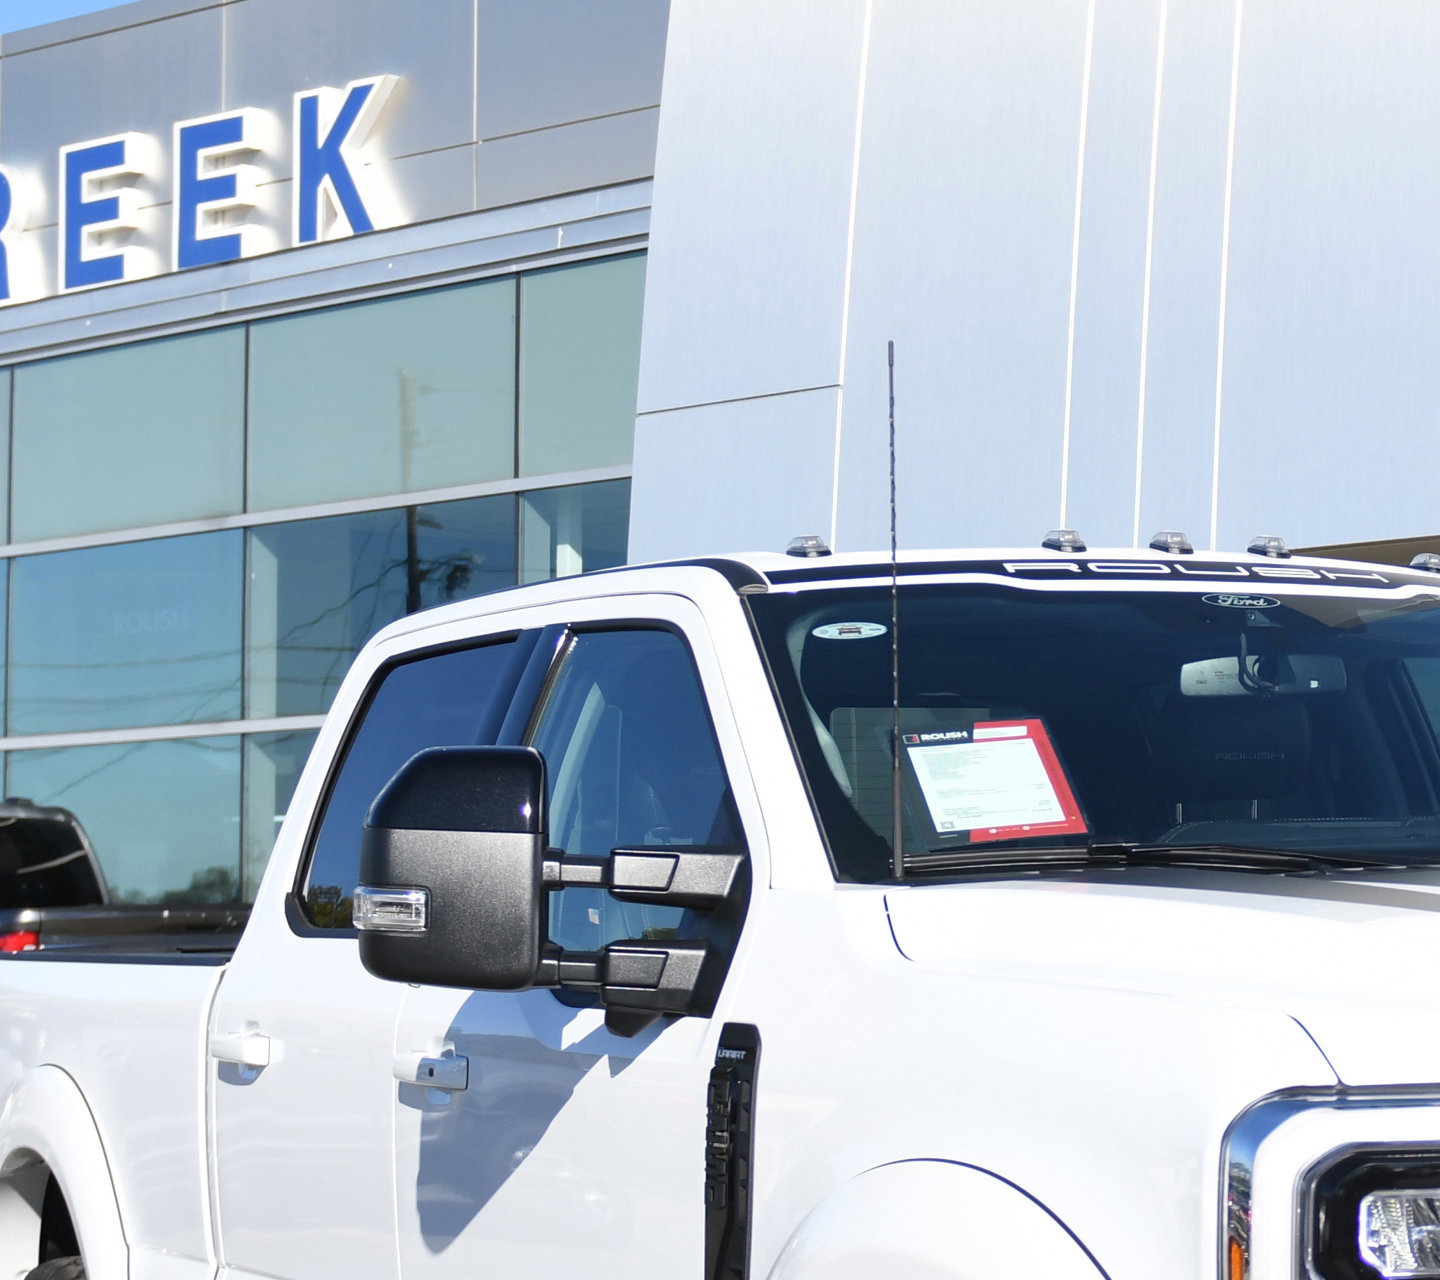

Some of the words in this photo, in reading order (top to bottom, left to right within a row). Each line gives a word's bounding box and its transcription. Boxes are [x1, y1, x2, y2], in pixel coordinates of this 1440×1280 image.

[1001, 561, 1391, 584] ROUSH
[1217, 594, 1268, 607] Ford
[920, 730, 969, 742] ROUSH
